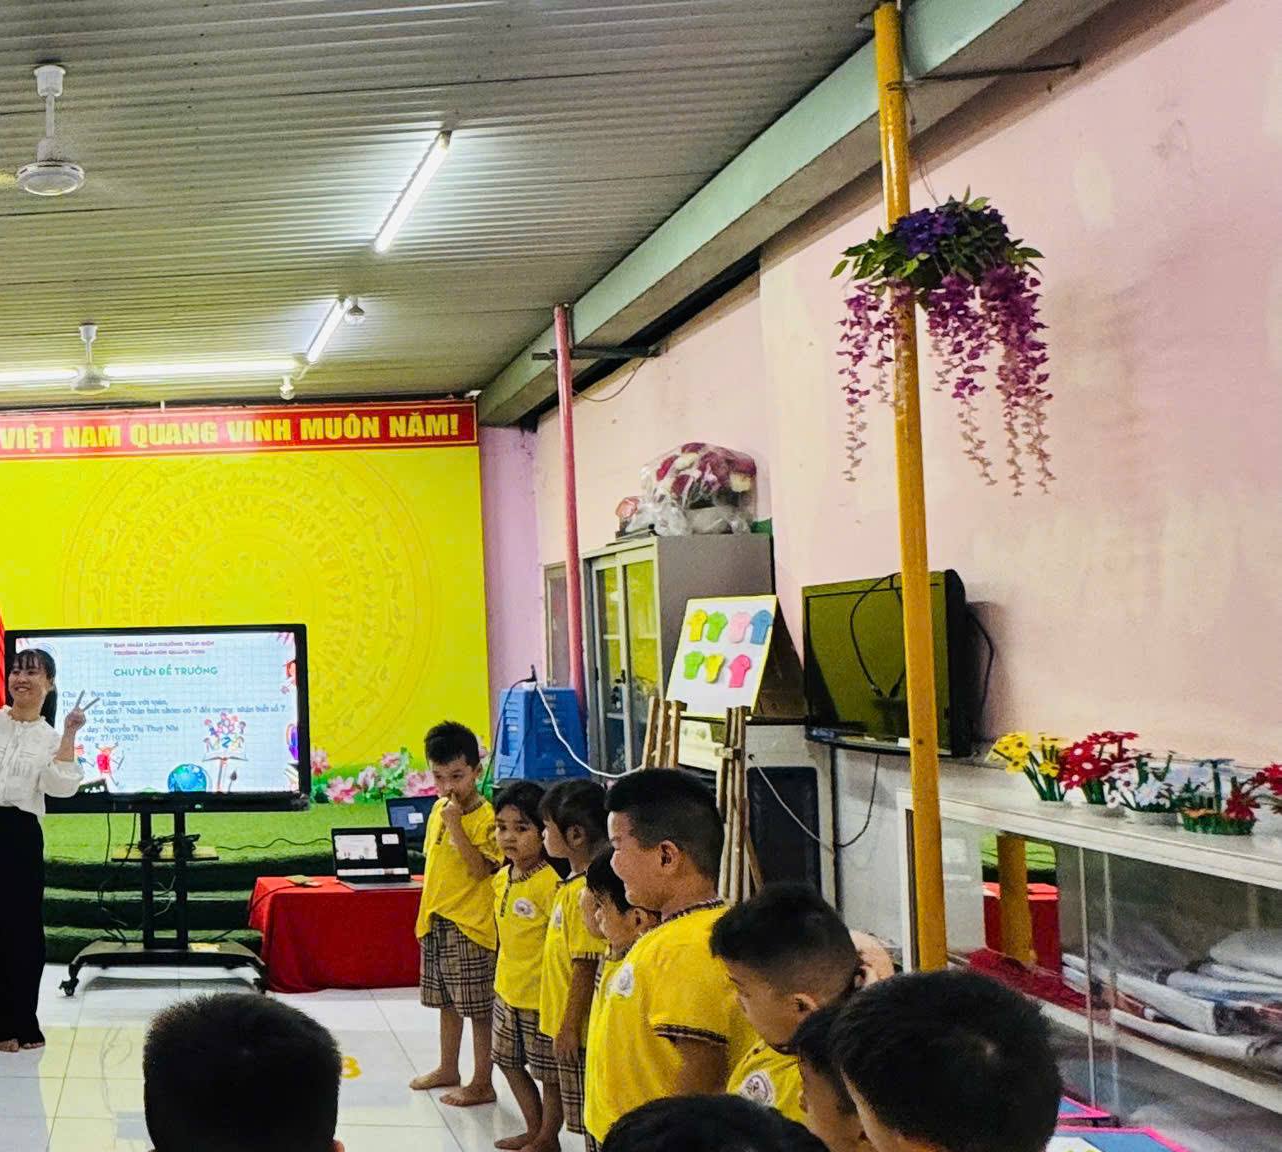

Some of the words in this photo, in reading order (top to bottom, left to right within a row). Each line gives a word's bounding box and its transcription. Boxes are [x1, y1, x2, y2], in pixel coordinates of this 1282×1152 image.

[62, 425, 122, 449] NAM
[129, 422, 218, 449] QUANG
[226, 418, 292, 443] VINH
[299, 413, 381, 441] MUÔN
[388, 411, 460, 438] NĂM!
